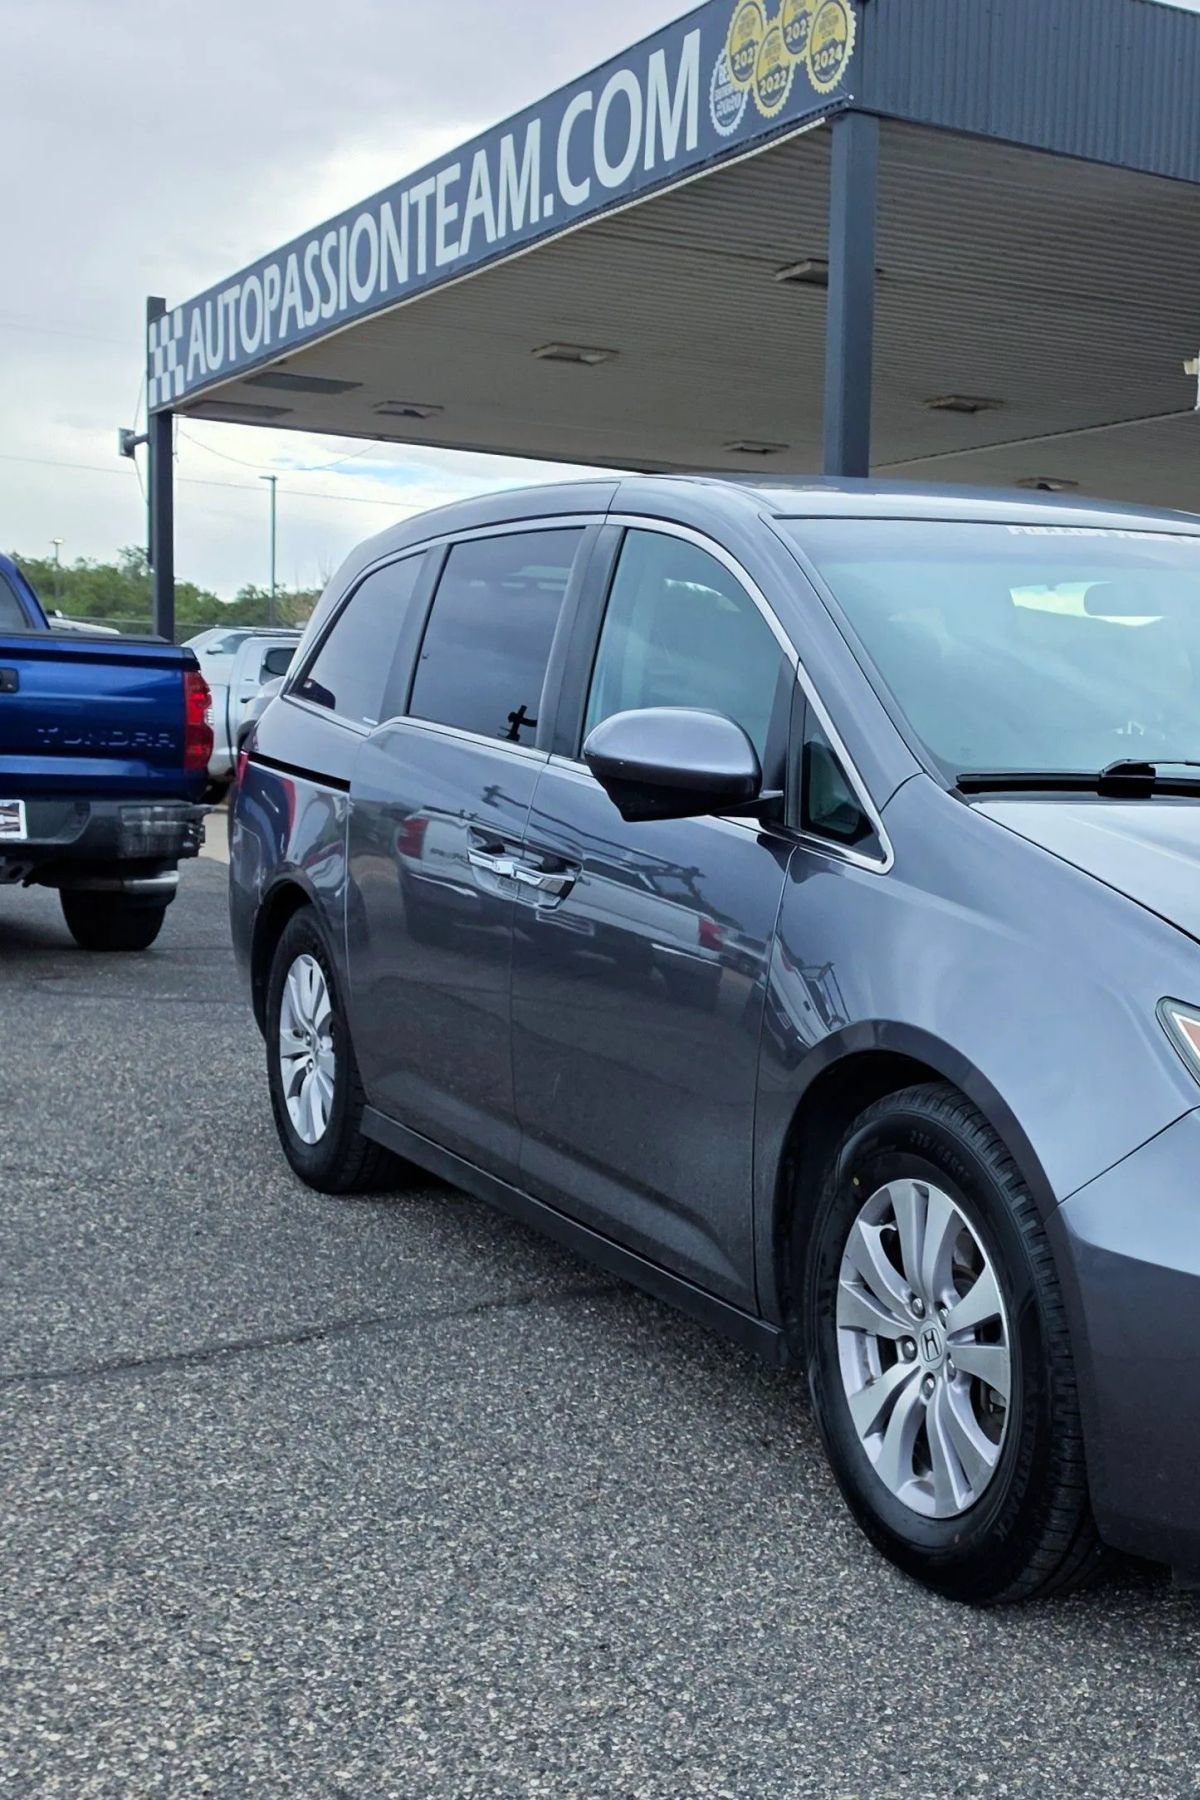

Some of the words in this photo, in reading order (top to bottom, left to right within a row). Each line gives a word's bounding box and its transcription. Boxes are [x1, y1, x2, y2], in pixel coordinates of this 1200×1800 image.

[814, 44, 844, 71] 2024
[759, 70, 788, 96] 2022
[183, 28, 701, 383] AUTOPASSIONTEAM.COM
